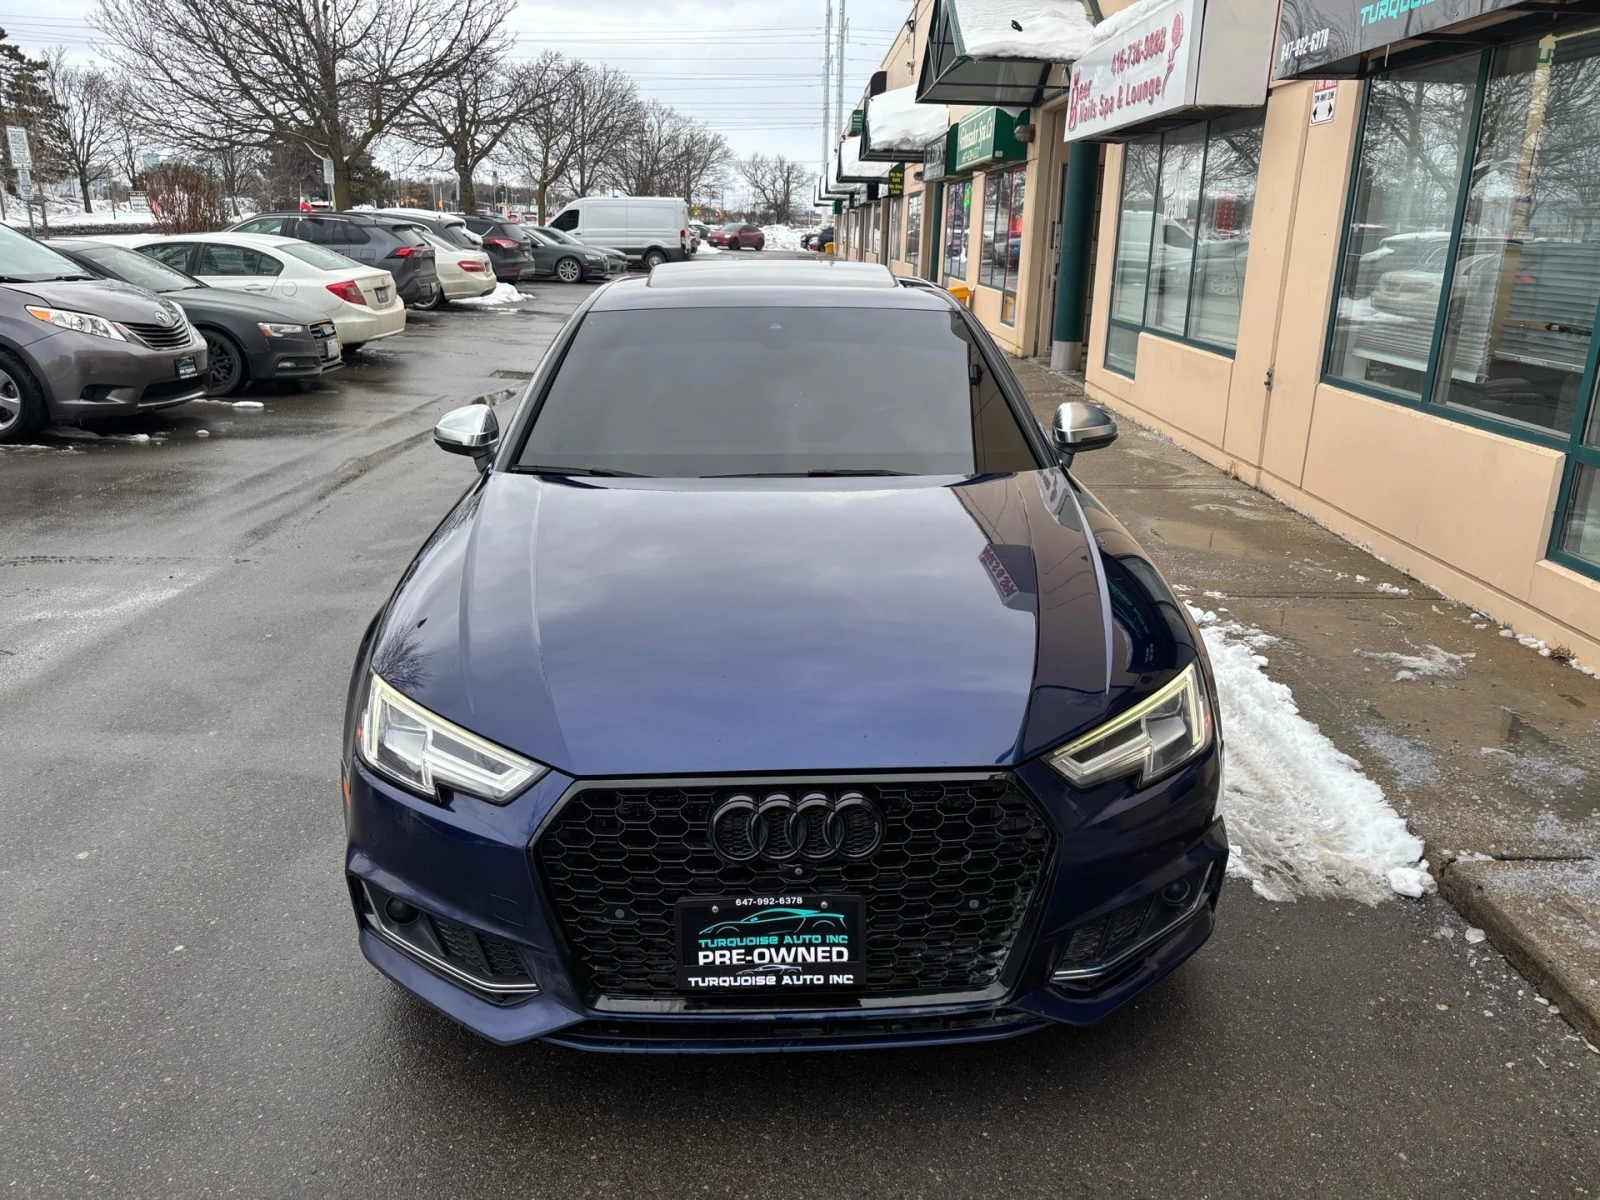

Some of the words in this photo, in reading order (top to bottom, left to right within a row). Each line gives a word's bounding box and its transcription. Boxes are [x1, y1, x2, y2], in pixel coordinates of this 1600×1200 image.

[1079, 99, 1097, 124] Nails
[1099, 94, 1114, 121] Spa
[1117, 85, 1123, 110] &
[1126, 76, 1161, 106] Lounge
[735, 897, 803, 906] 647-992-6378
[698, 937, 779, 948] TURQUOISE
[783, 935, 822, 945] AUTO
[826, 935, 848, 944] INC
[698, 946, 849, 966] PRE-OWNED
[688, 976, 776, 987] TURQUOISE
[781, 975, 824, 985] AUTO
[829, 974, 854, 984] INC
